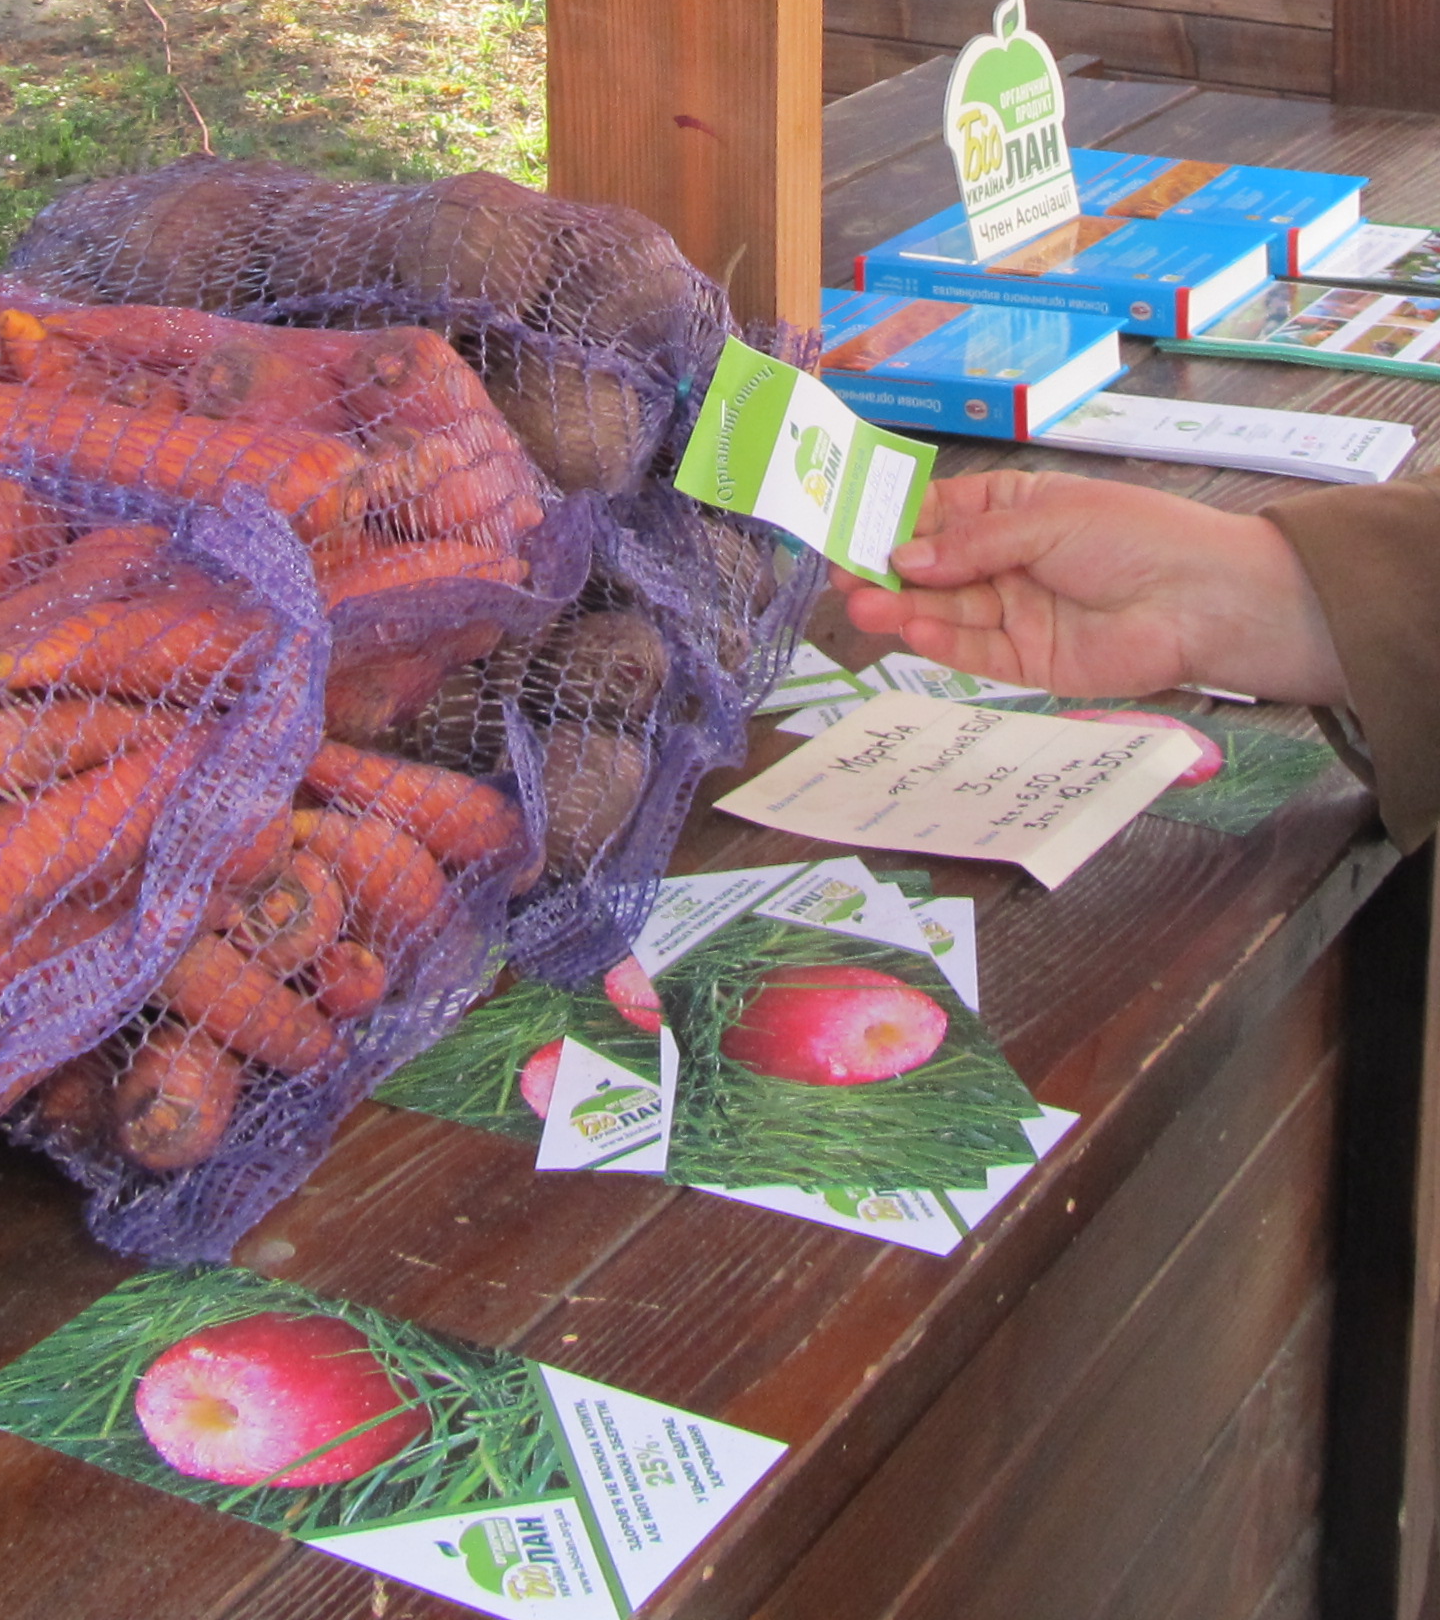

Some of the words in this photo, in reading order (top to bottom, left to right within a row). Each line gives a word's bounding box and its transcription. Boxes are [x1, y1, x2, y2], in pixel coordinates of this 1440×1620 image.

[1014, 94, 1053, 124] ПРОДУКТ
[1005, 122, 1061, 189] ЛАН
[965, 176, 1006, 208] УКРАЇНА
[978, 219, 1014, 244] Член
[1016, 184, 1072, 226] Асоціації
[733, 363, 777, 408] овочі
[828, 724, 921, 774] Морква
[589, 1440, 615, 1483] МОЖНА
[616, 1452, 642, 1493] МОЖНА
[604, 1481, 623, 1498] НЕ
[515, 1515, 561, 1565] ЛАН
[642, 1521, 663, 1544] АЛЕ
